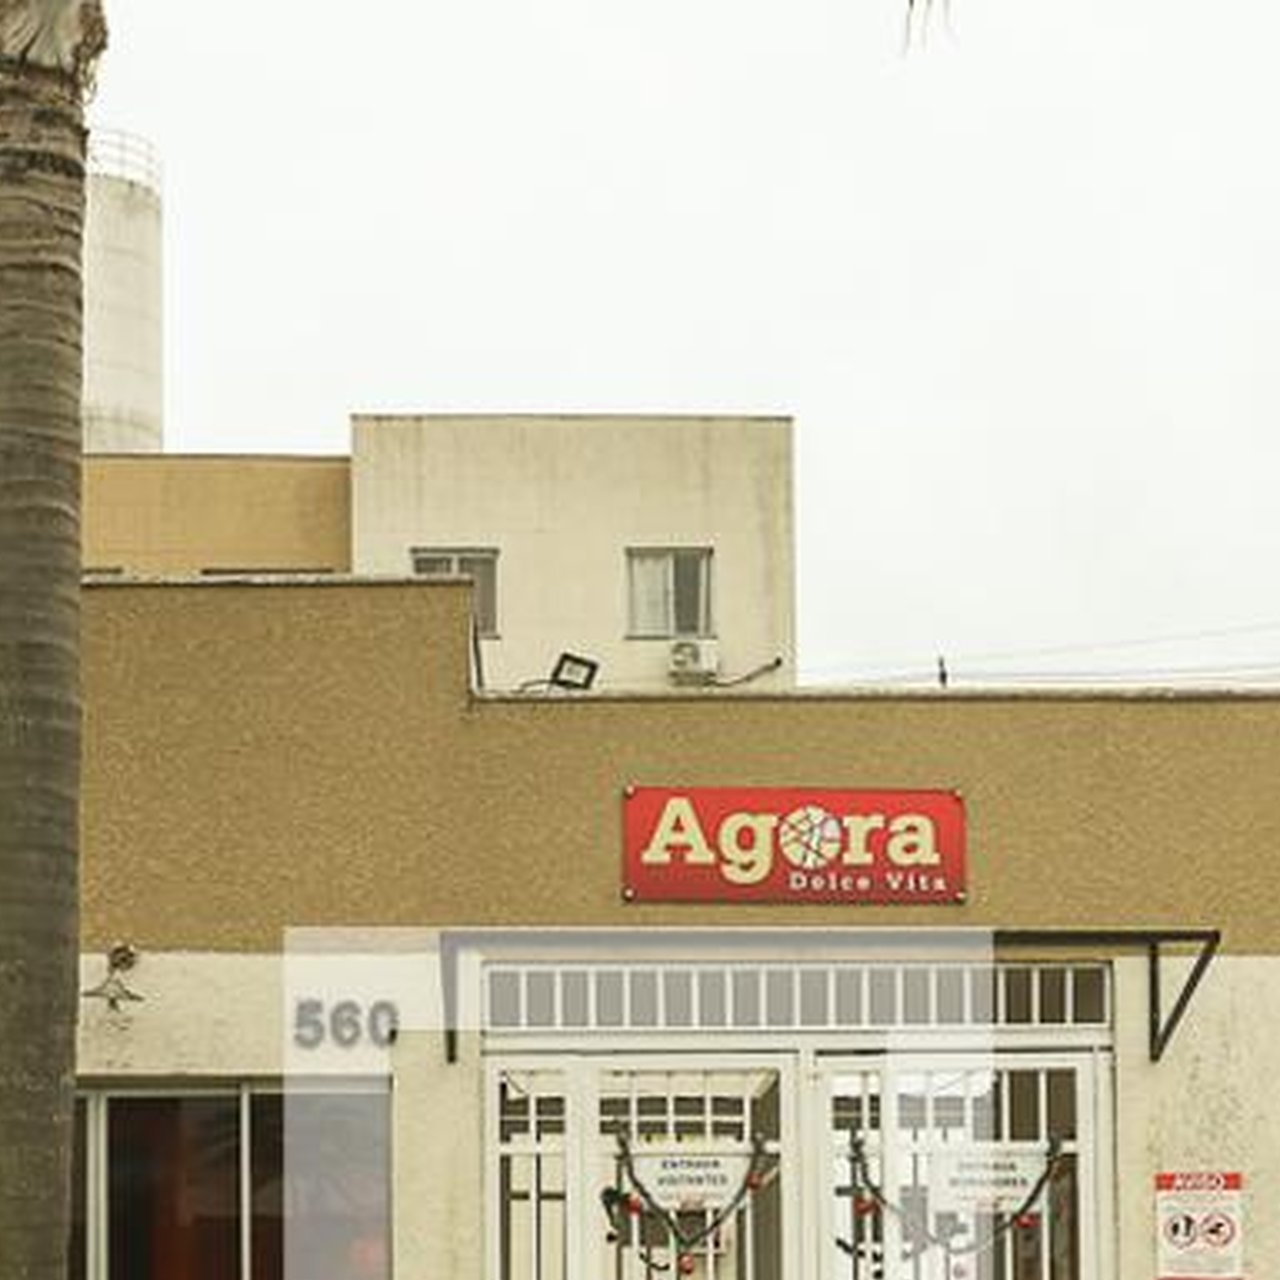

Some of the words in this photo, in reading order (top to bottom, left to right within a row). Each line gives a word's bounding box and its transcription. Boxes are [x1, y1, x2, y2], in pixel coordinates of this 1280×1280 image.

[640, 796, 942, 885] Agora
[789, 872, 871, 891] Dolce
[887, 872, 947, 891] Vita
[293, 998, 400, 1050] 560
